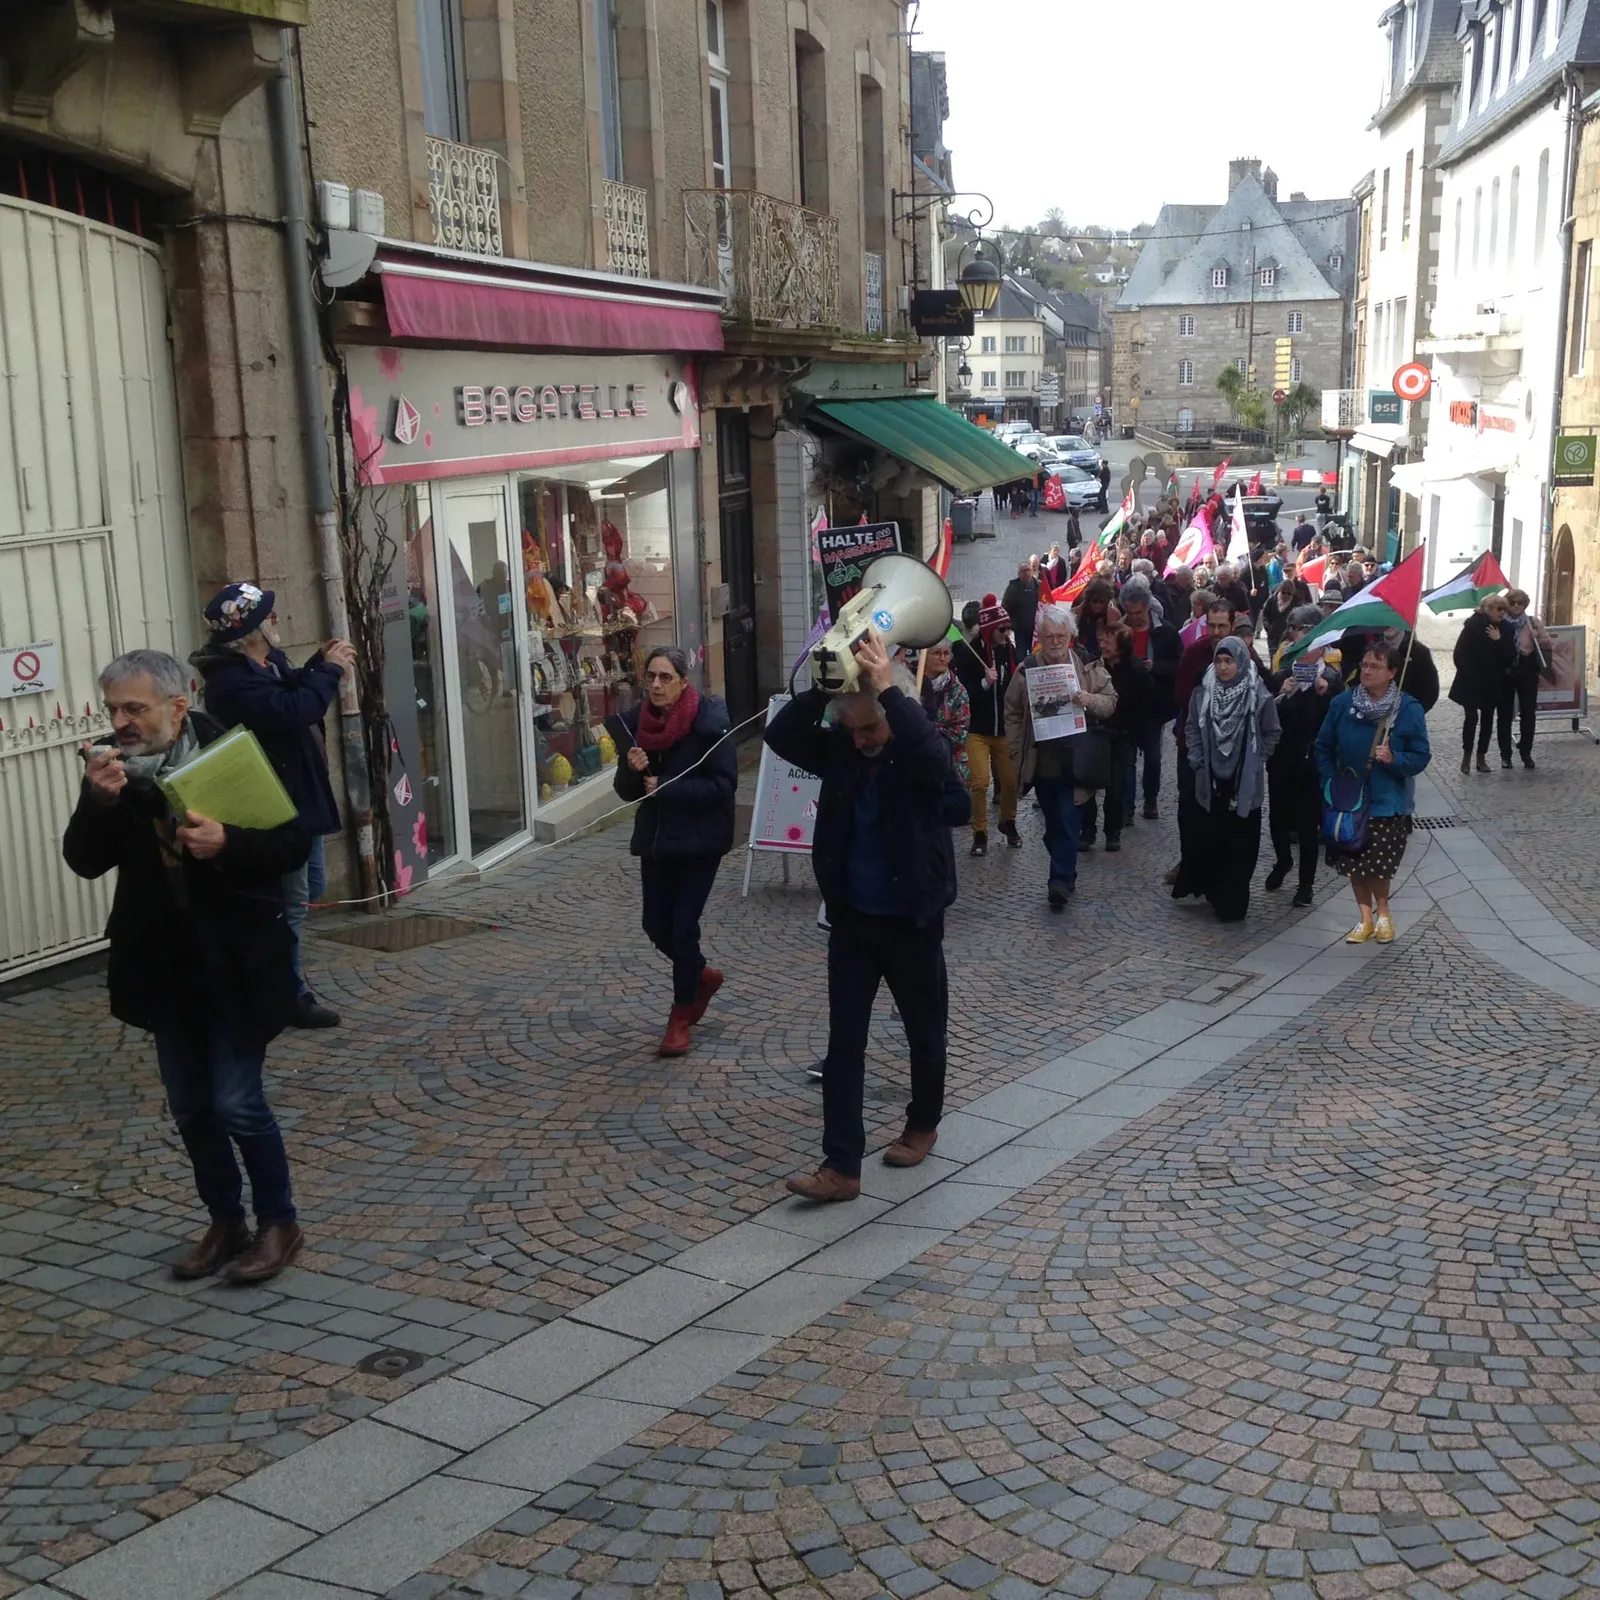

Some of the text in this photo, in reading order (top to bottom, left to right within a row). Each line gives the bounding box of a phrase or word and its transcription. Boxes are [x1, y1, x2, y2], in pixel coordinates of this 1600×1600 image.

[459, 384, 648, 426] BAGATELLE
[822, 533, 874, 548] HALTE
[823, 537, 894, 563] MASSACRE
